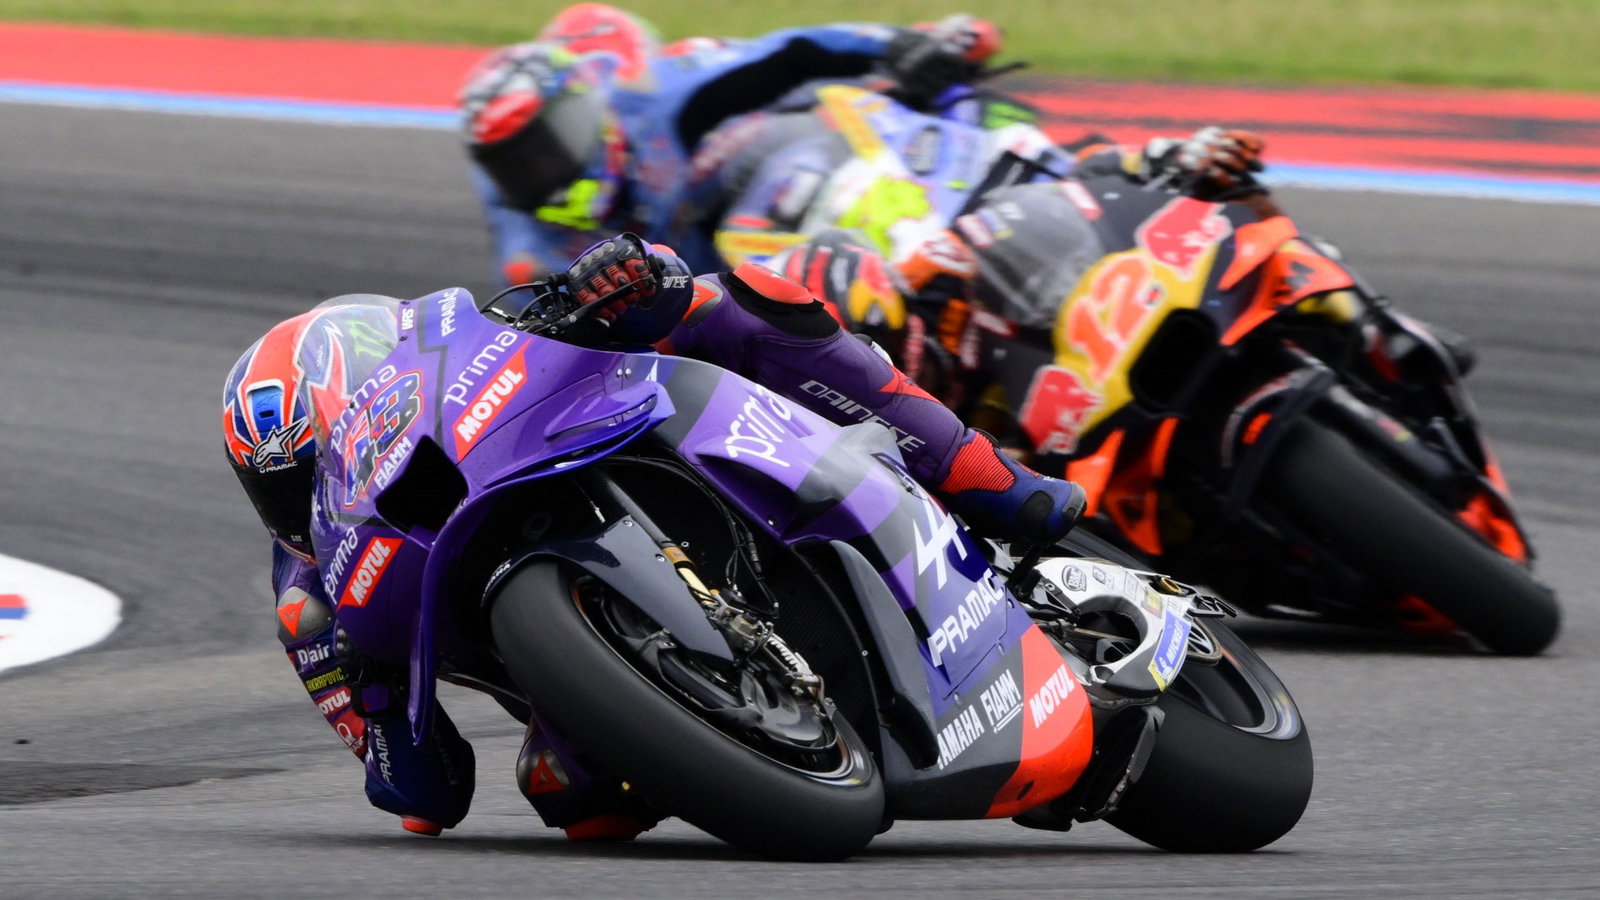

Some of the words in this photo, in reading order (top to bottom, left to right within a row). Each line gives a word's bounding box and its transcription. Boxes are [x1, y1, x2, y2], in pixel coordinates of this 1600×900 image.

[1065, 254, 1152, 383] 12
[443, 330, 519, 407] prima
[456, 368, 524, 443] MOTUL
[331, 364, 397, 455] prima
[724, 383, 792, 468] prima
[373, 435, 414, 490] FIAMM
[324, 526, 359, 605] prima
[349, 539, 391, 606] MOTUL
[927, 567, 1005, 668] PRAMAC
[317, 690, 351, 715] OTUL
[936, 704, 985, 771] AMAHA
[979, 668, 1023, 729] FIAMM
[1029, 664, 1075, 729] MOTUL
